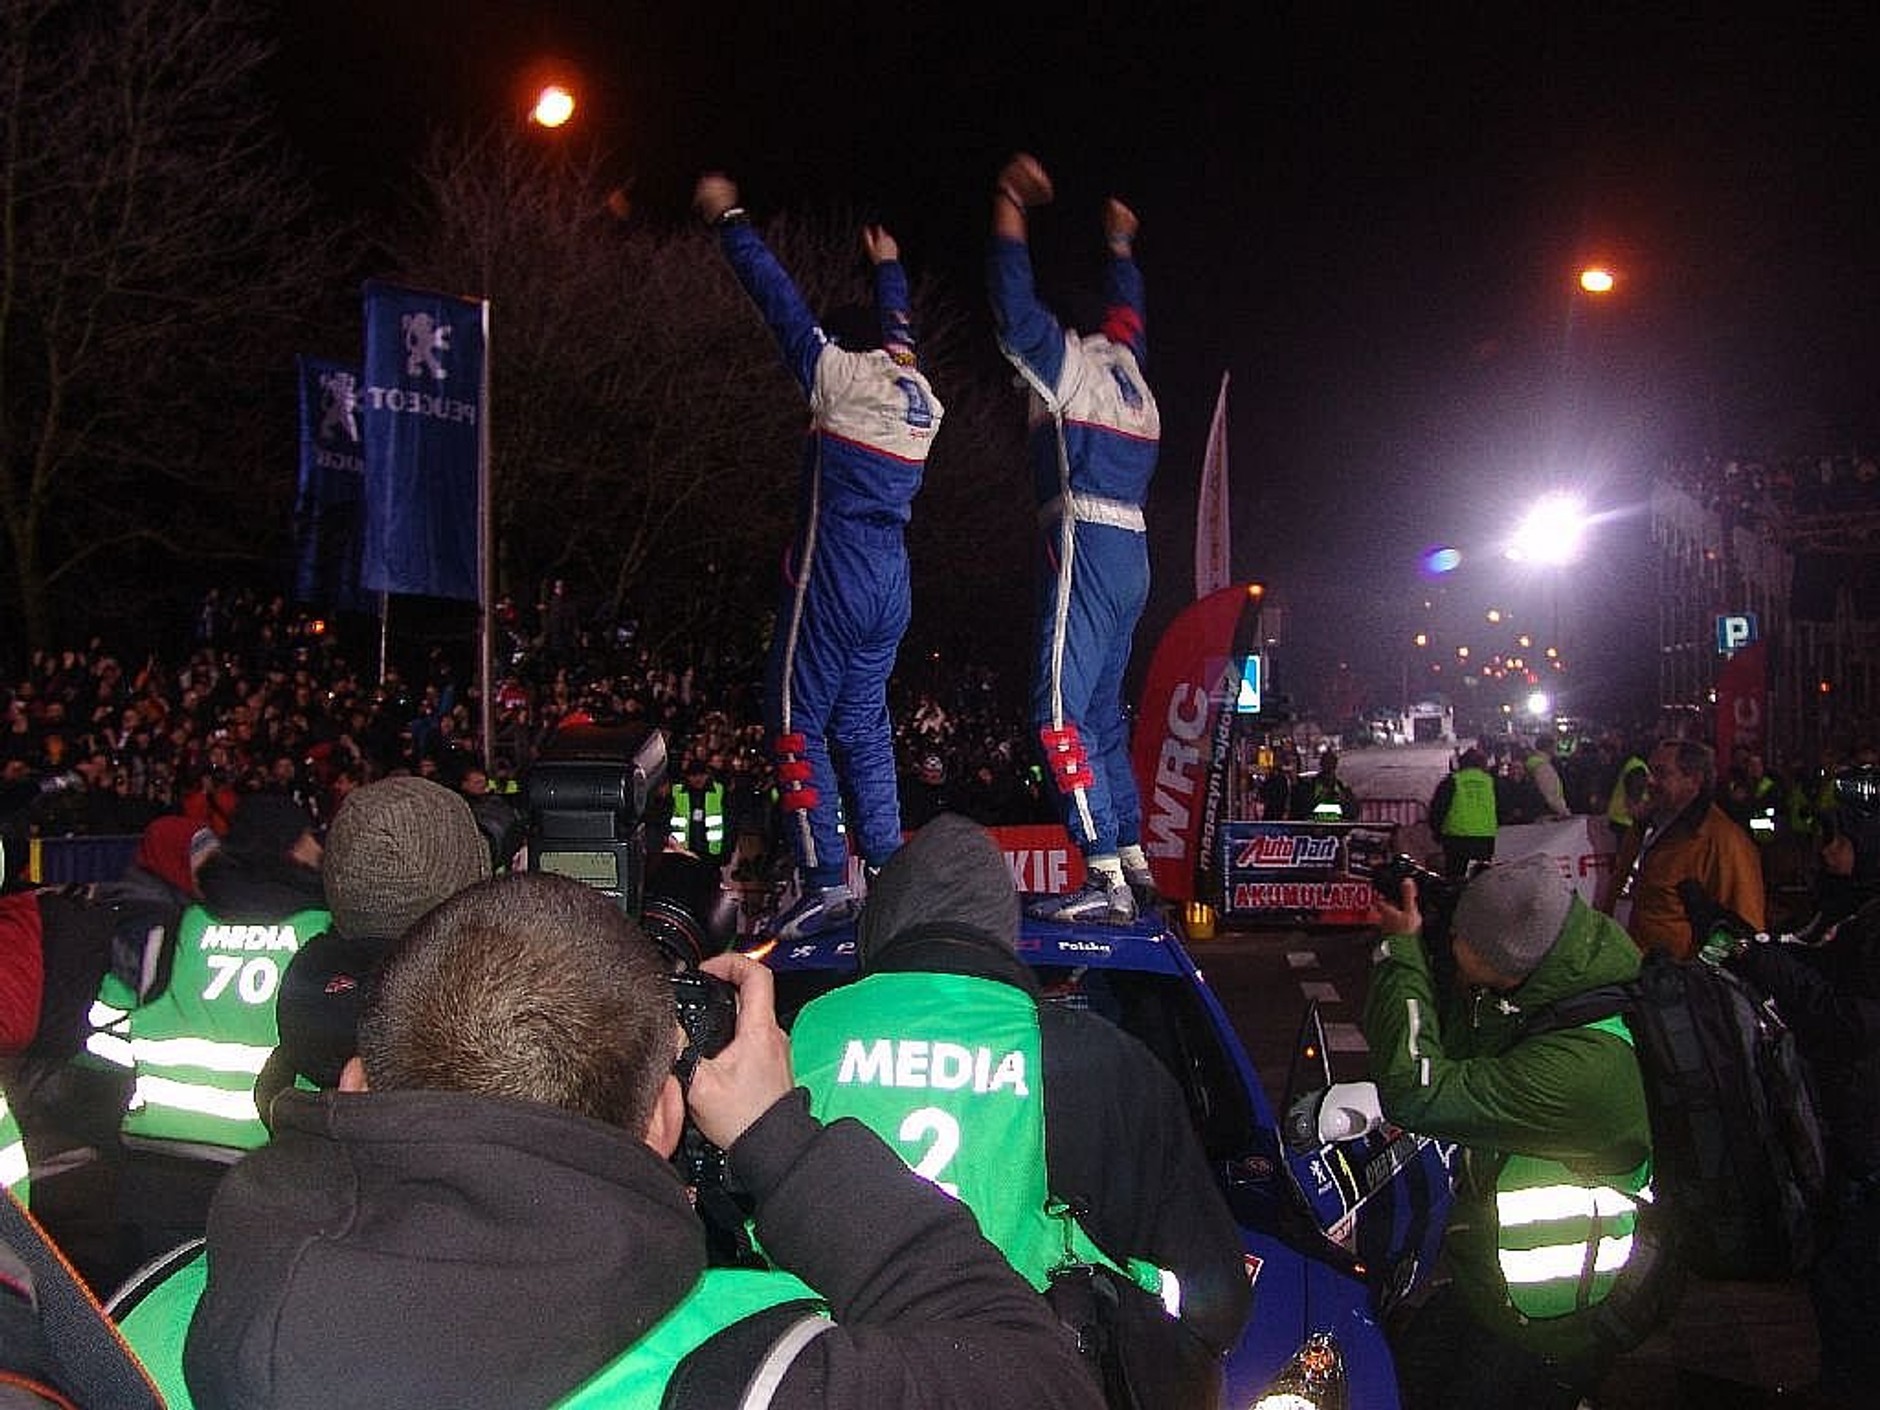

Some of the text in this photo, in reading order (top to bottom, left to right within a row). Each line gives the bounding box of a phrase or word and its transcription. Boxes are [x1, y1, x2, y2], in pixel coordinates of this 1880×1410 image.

[1726, 616, 1749, 648] P
[1149, 683, 1209, 859] WRC
[201, 925, 299, 951] MEDIA
[202, 956, 280, 1004] 70
[837, 1038, 1029, 1096] MEDIA
[899, 1106, 961, 1199] 2
